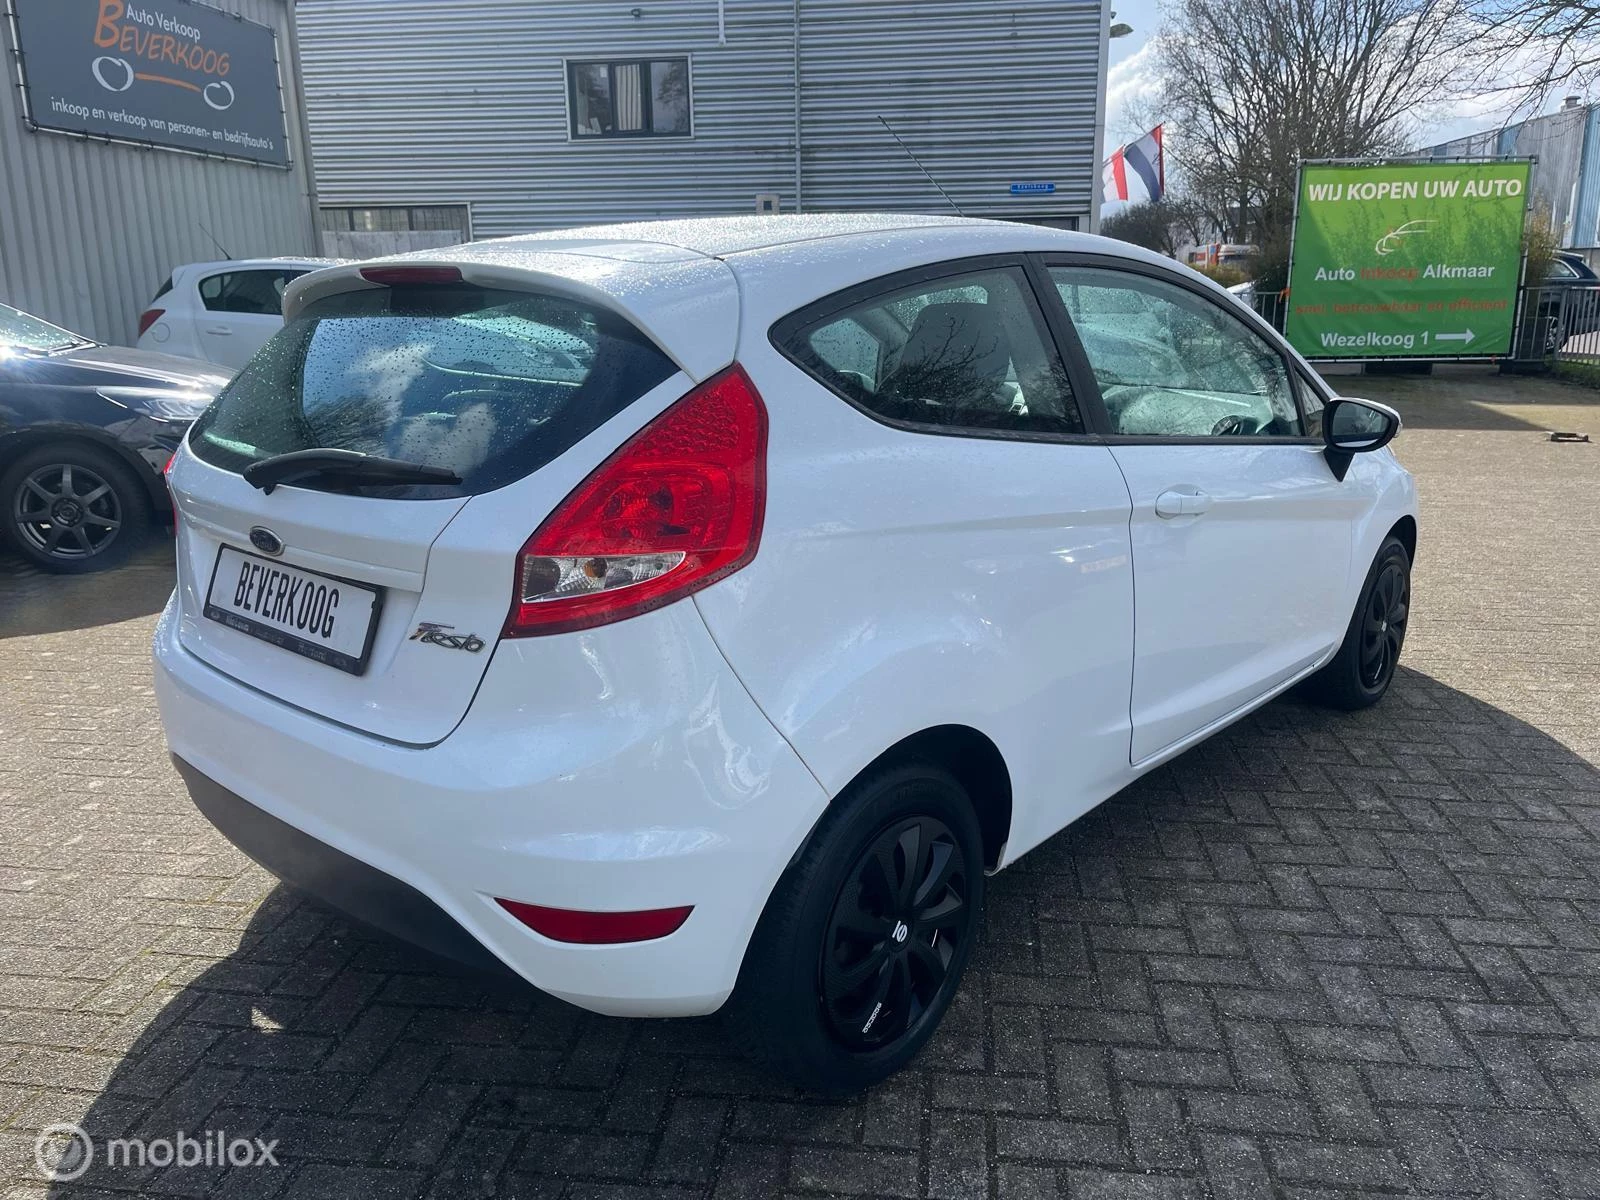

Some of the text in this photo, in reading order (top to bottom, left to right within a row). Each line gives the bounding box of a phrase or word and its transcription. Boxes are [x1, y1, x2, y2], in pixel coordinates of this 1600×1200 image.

[93, 0, 231, 76] BEVERKOOG
[126, 3, 201, 42] Auto Verkoop
[51, 96, 274, 150] inkoop en verkoop van personen- en bedrijfsauto's
[1308, 179, 1522, 201] WIJ KOPEN UW AUTO
[1315, 267, 1355, 281] Auto
[1422, 264, 1495, 279] Alkmaar
[1320, 331, 1429, 348] Wezelkoog 1
[233, 561, 340, 639] BEVERKOOG
